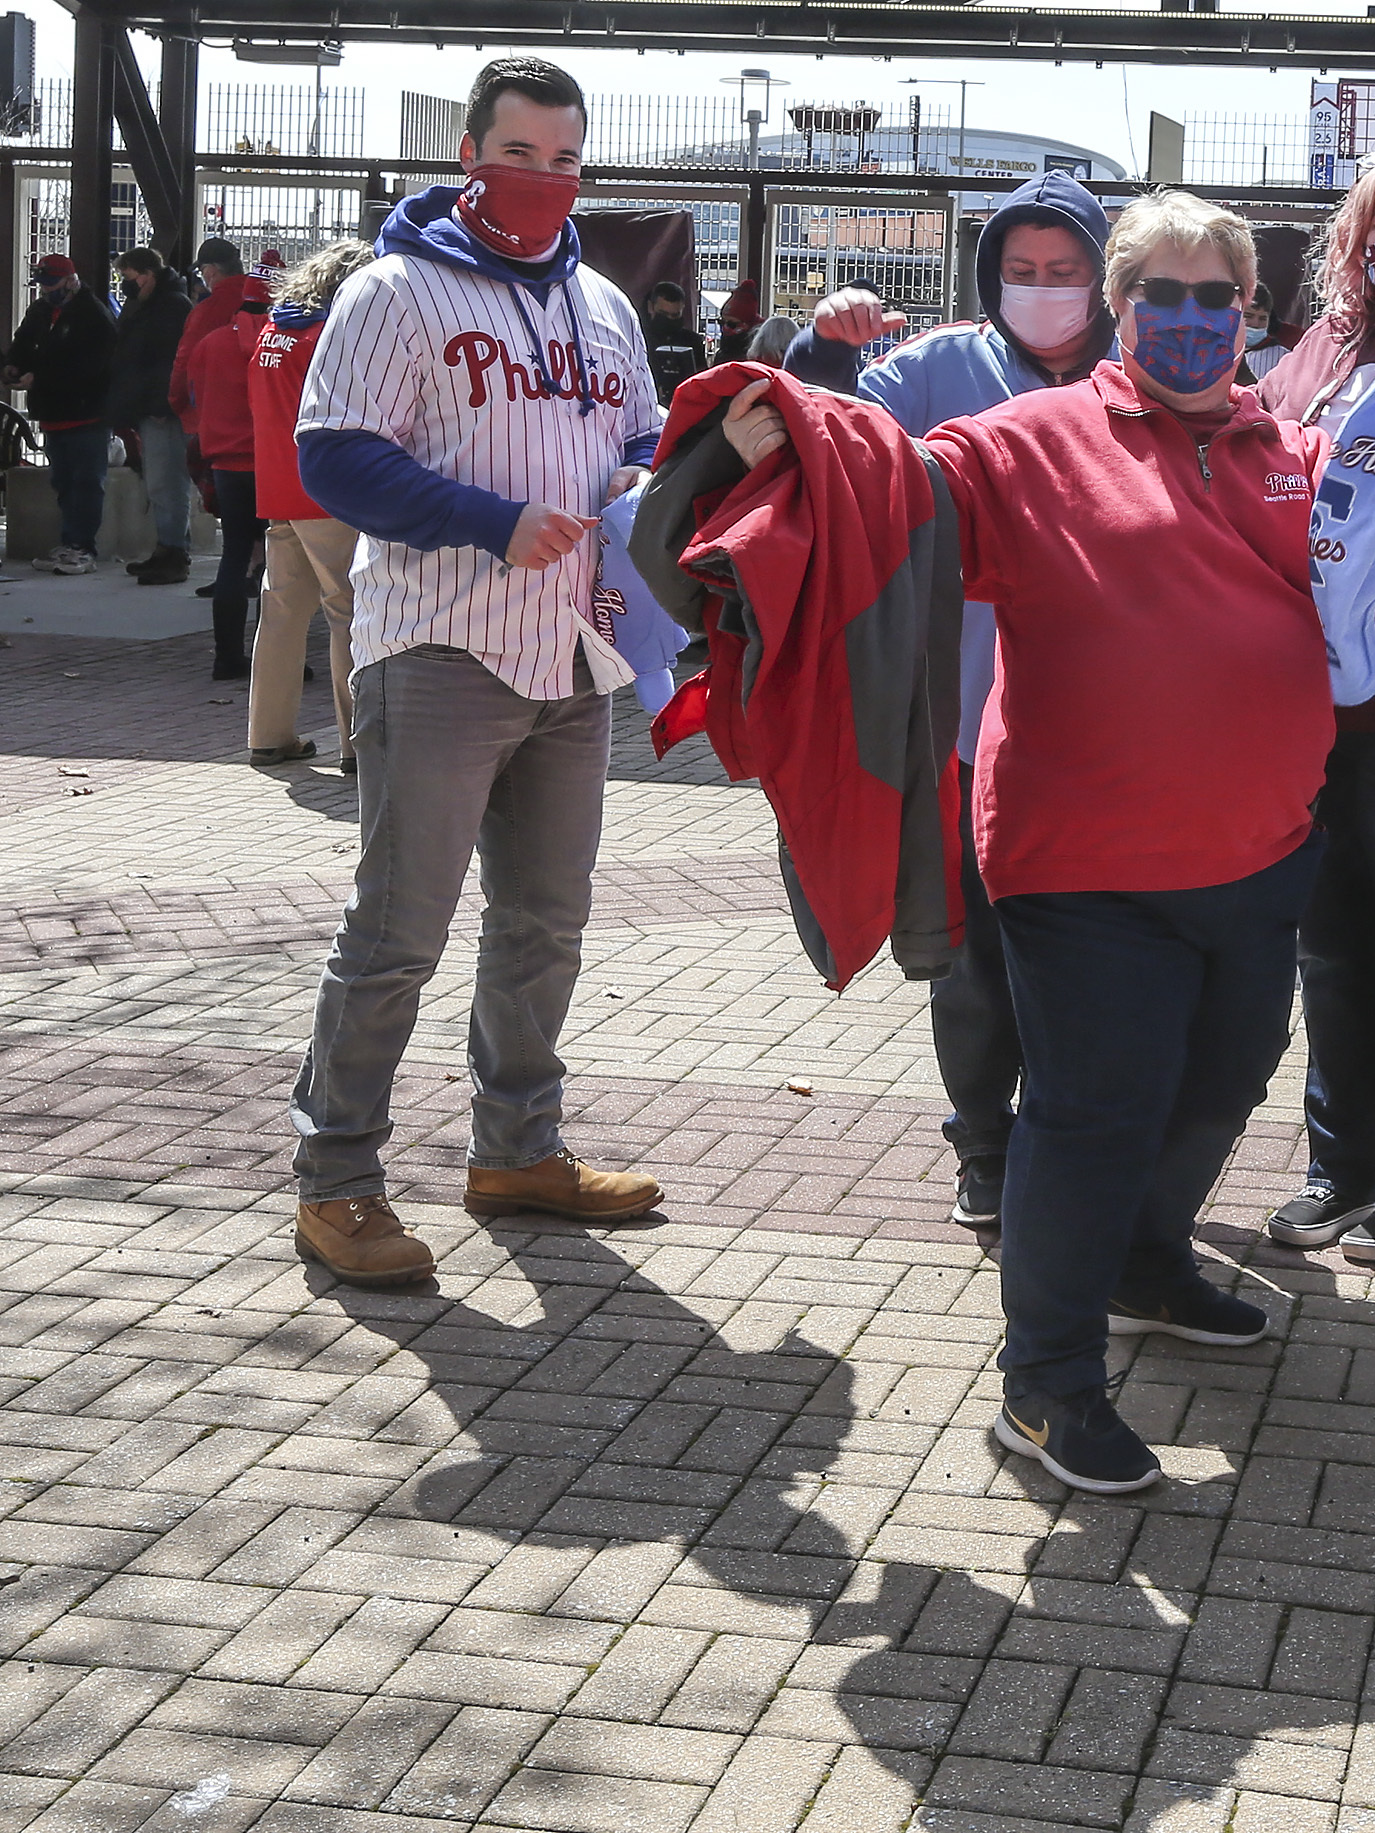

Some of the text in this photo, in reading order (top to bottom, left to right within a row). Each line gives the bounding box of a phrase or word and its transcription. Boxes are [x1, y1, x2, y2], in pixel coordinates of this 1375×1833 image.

[1316, 111, 1332, 122] 95
[1315, 132, 1332, 144] 2.6
[948, 156, 995, 169] WELLS
[996, 159, 1038, 172] FARGO
[974, 169, 1013, 178] CENTER
[260, 332, 298, 352] ELCOME
[443, 330, 626, 409] Phillie
[593, 585, 627, 646] Home
